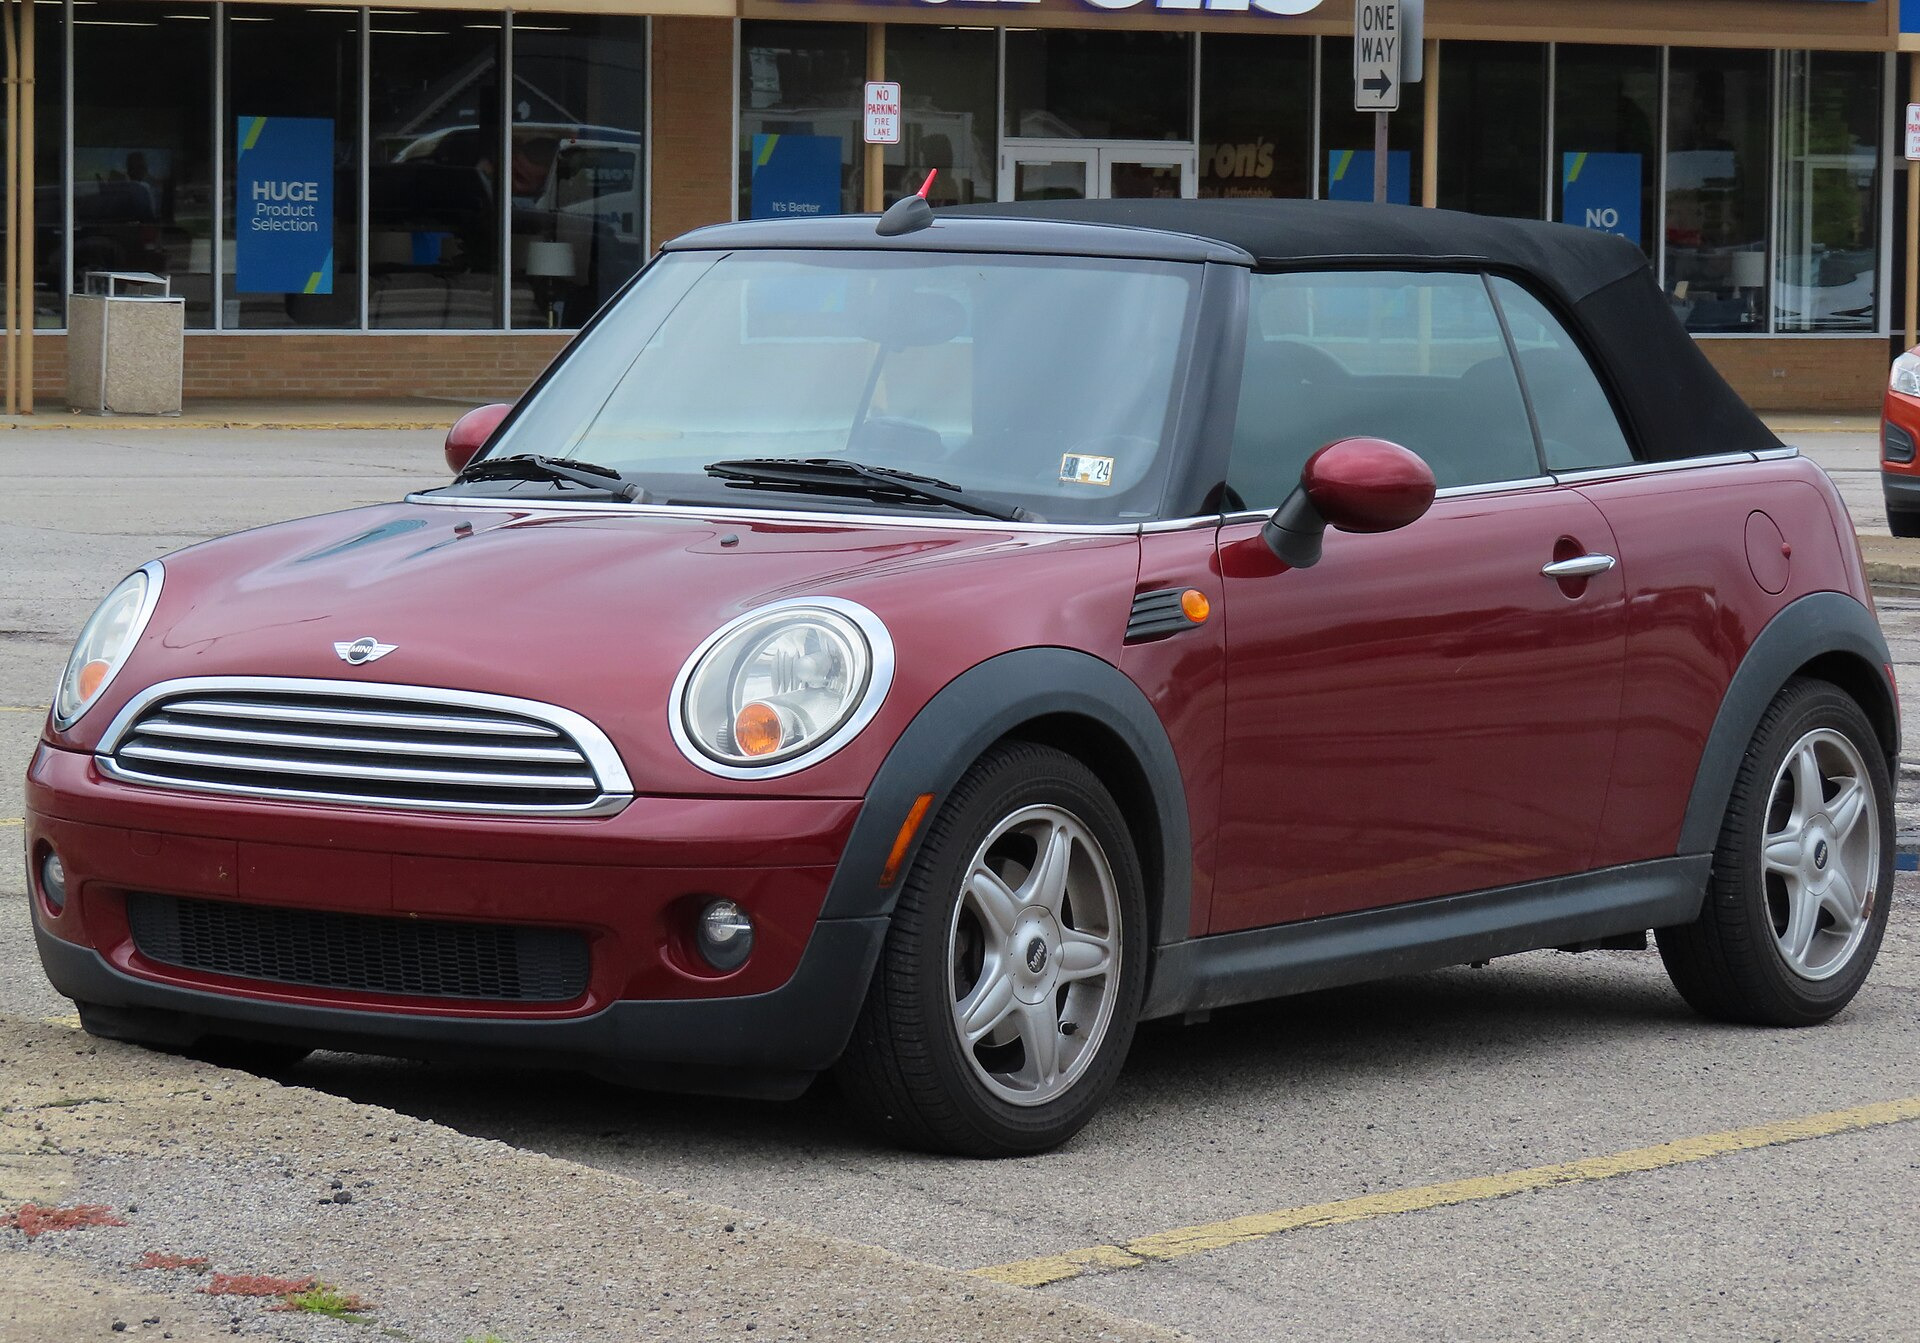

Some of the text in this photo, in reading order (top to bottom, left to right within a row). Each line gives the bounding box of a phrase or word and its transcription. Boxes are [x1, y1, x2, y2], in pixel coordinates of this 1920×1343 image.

[1363, 5, 1395, 31] ONE
[1361, 37, 1395, 62] WAY
[876, 89, 890, 101] NO
[867, 103, 898, 115] PARKING
[874, 117, 890, 126] FIRE
[873, 127, 891, 136] LANE
[252, 180, 319, 202] HUGE
[256, 202, 316, 217] Product
[772, 201, 821, 213] It's Better
[251, 217, 319, 233] Selection
[1585, 207, 1619, 229] NO
[1096, 460, 1110, 480] 24
[350, 645, 374, 654] MINI
[1030, 942, 1046, 968] MINI
